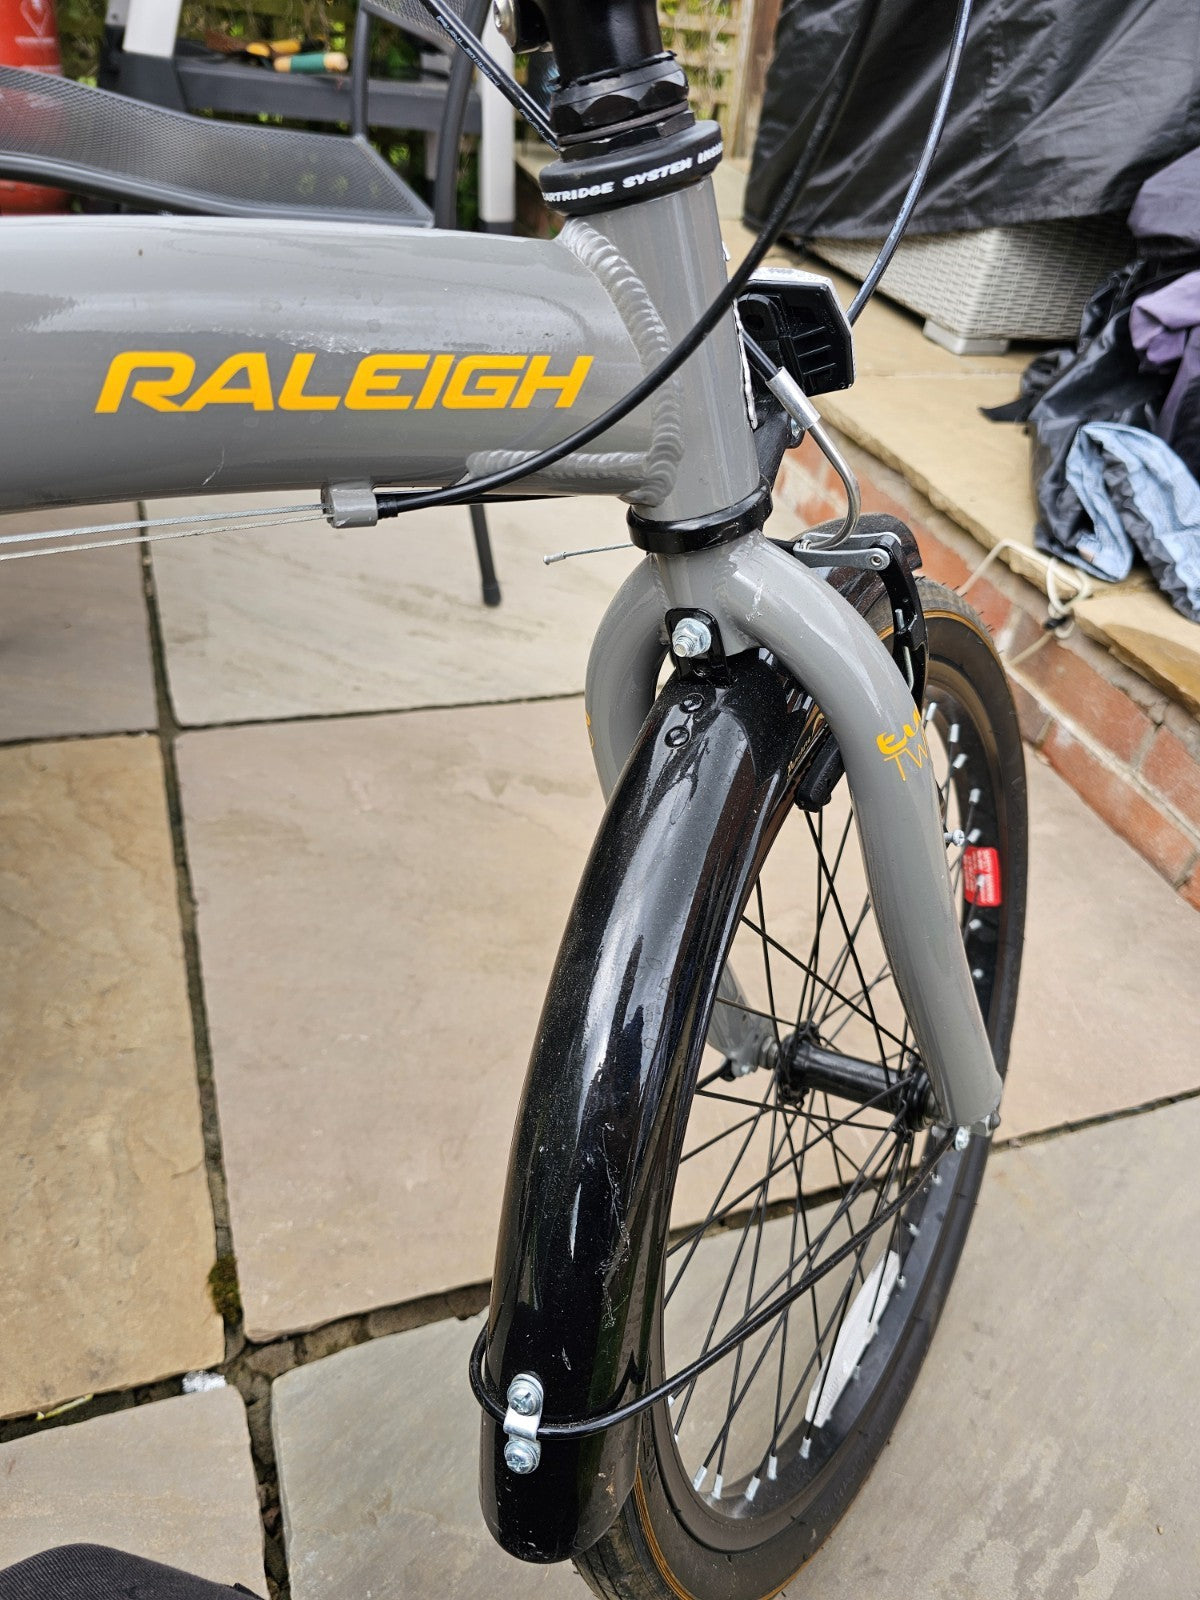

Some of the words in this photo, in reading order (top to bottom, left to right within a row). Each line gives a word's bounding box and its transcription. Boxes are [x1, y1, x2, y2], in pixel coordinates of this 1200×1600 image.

[622, 156, 693, 189] SYSTEM
[94, 350, 594, 413] RALEIGH
[883, 730, 929, 782] TW
